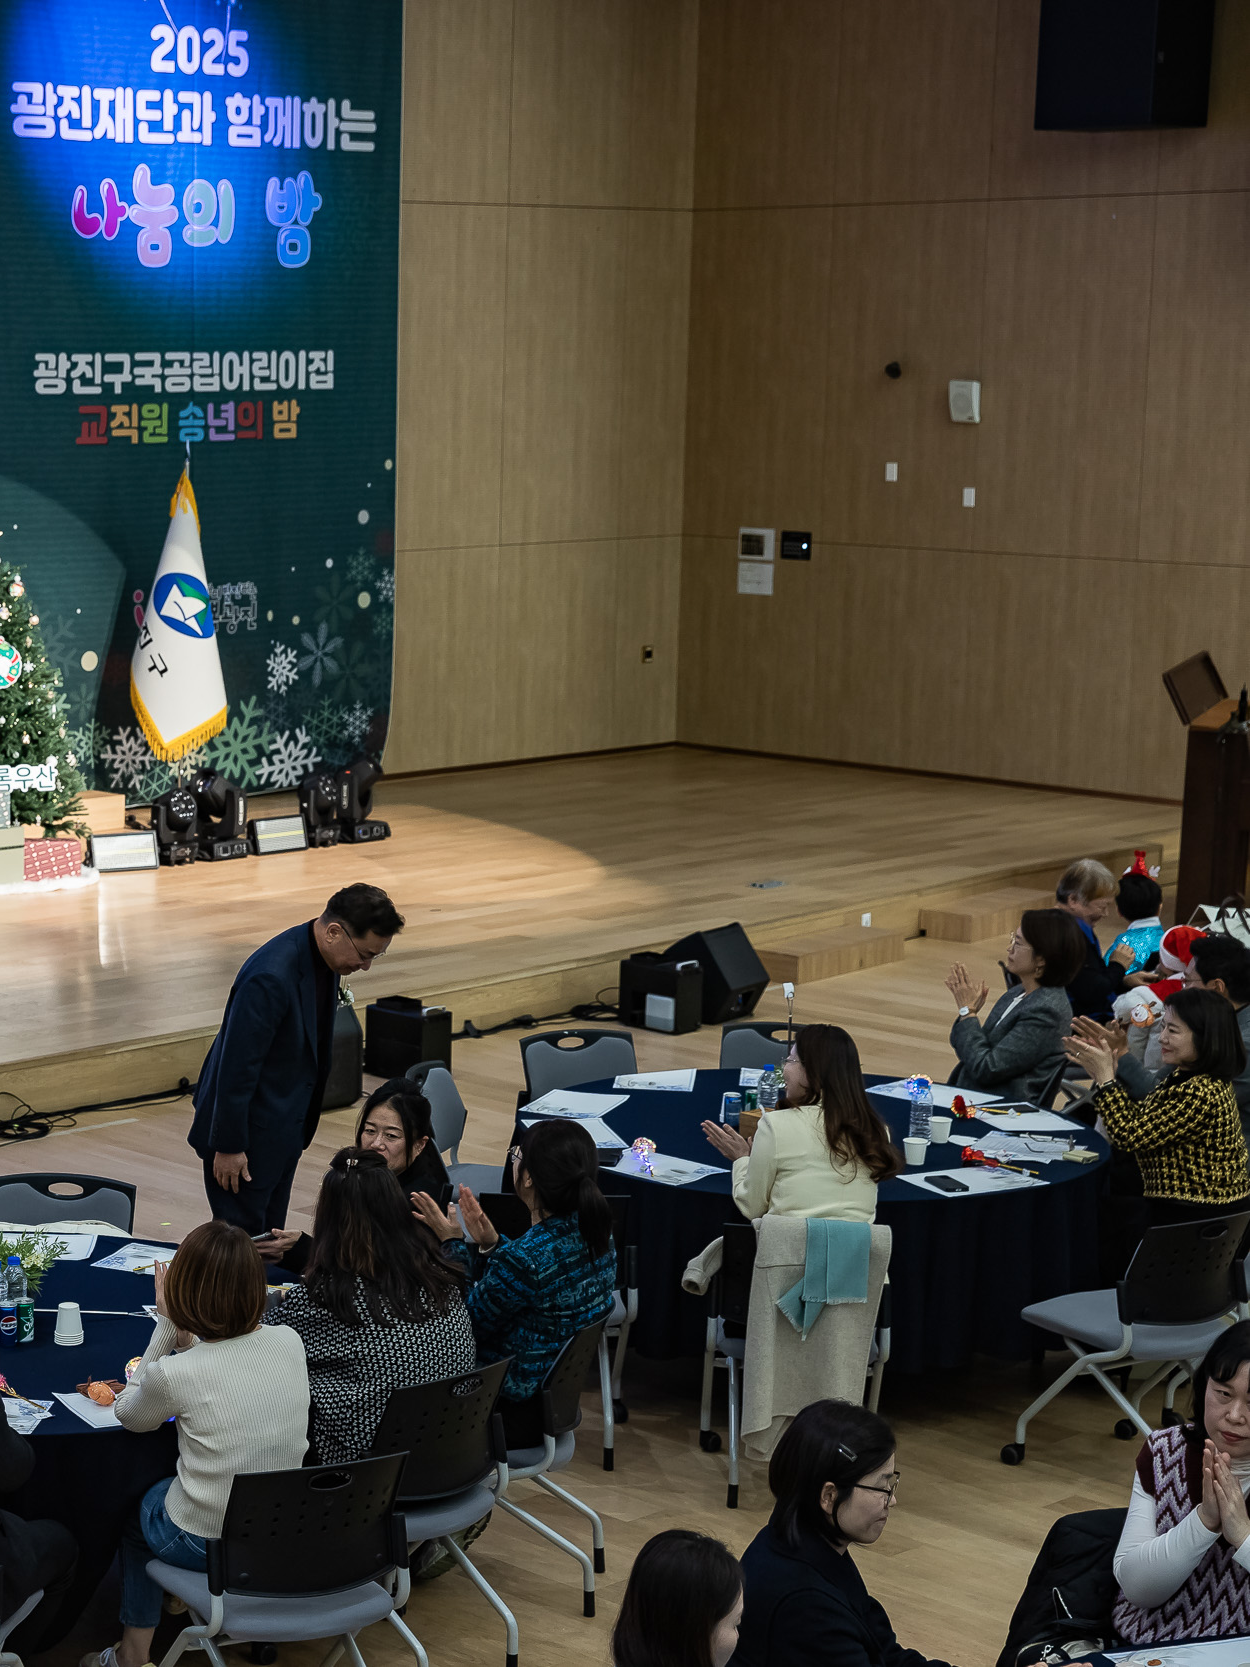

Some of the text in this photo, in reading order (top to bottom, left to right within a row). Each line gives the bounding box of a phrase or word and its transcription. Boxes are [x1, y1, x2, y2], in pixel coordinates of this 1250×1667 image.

[149, 23, 250, 78] 2025
[9, 81, 377, 153] 광진재단과 함께하는
[71, 163, 323, 269] 나눔의 밤
[33, 349, 335, 395] 광진구국공립어린이집
[75, 399, 301, 445] 교직원 송년의 밤
